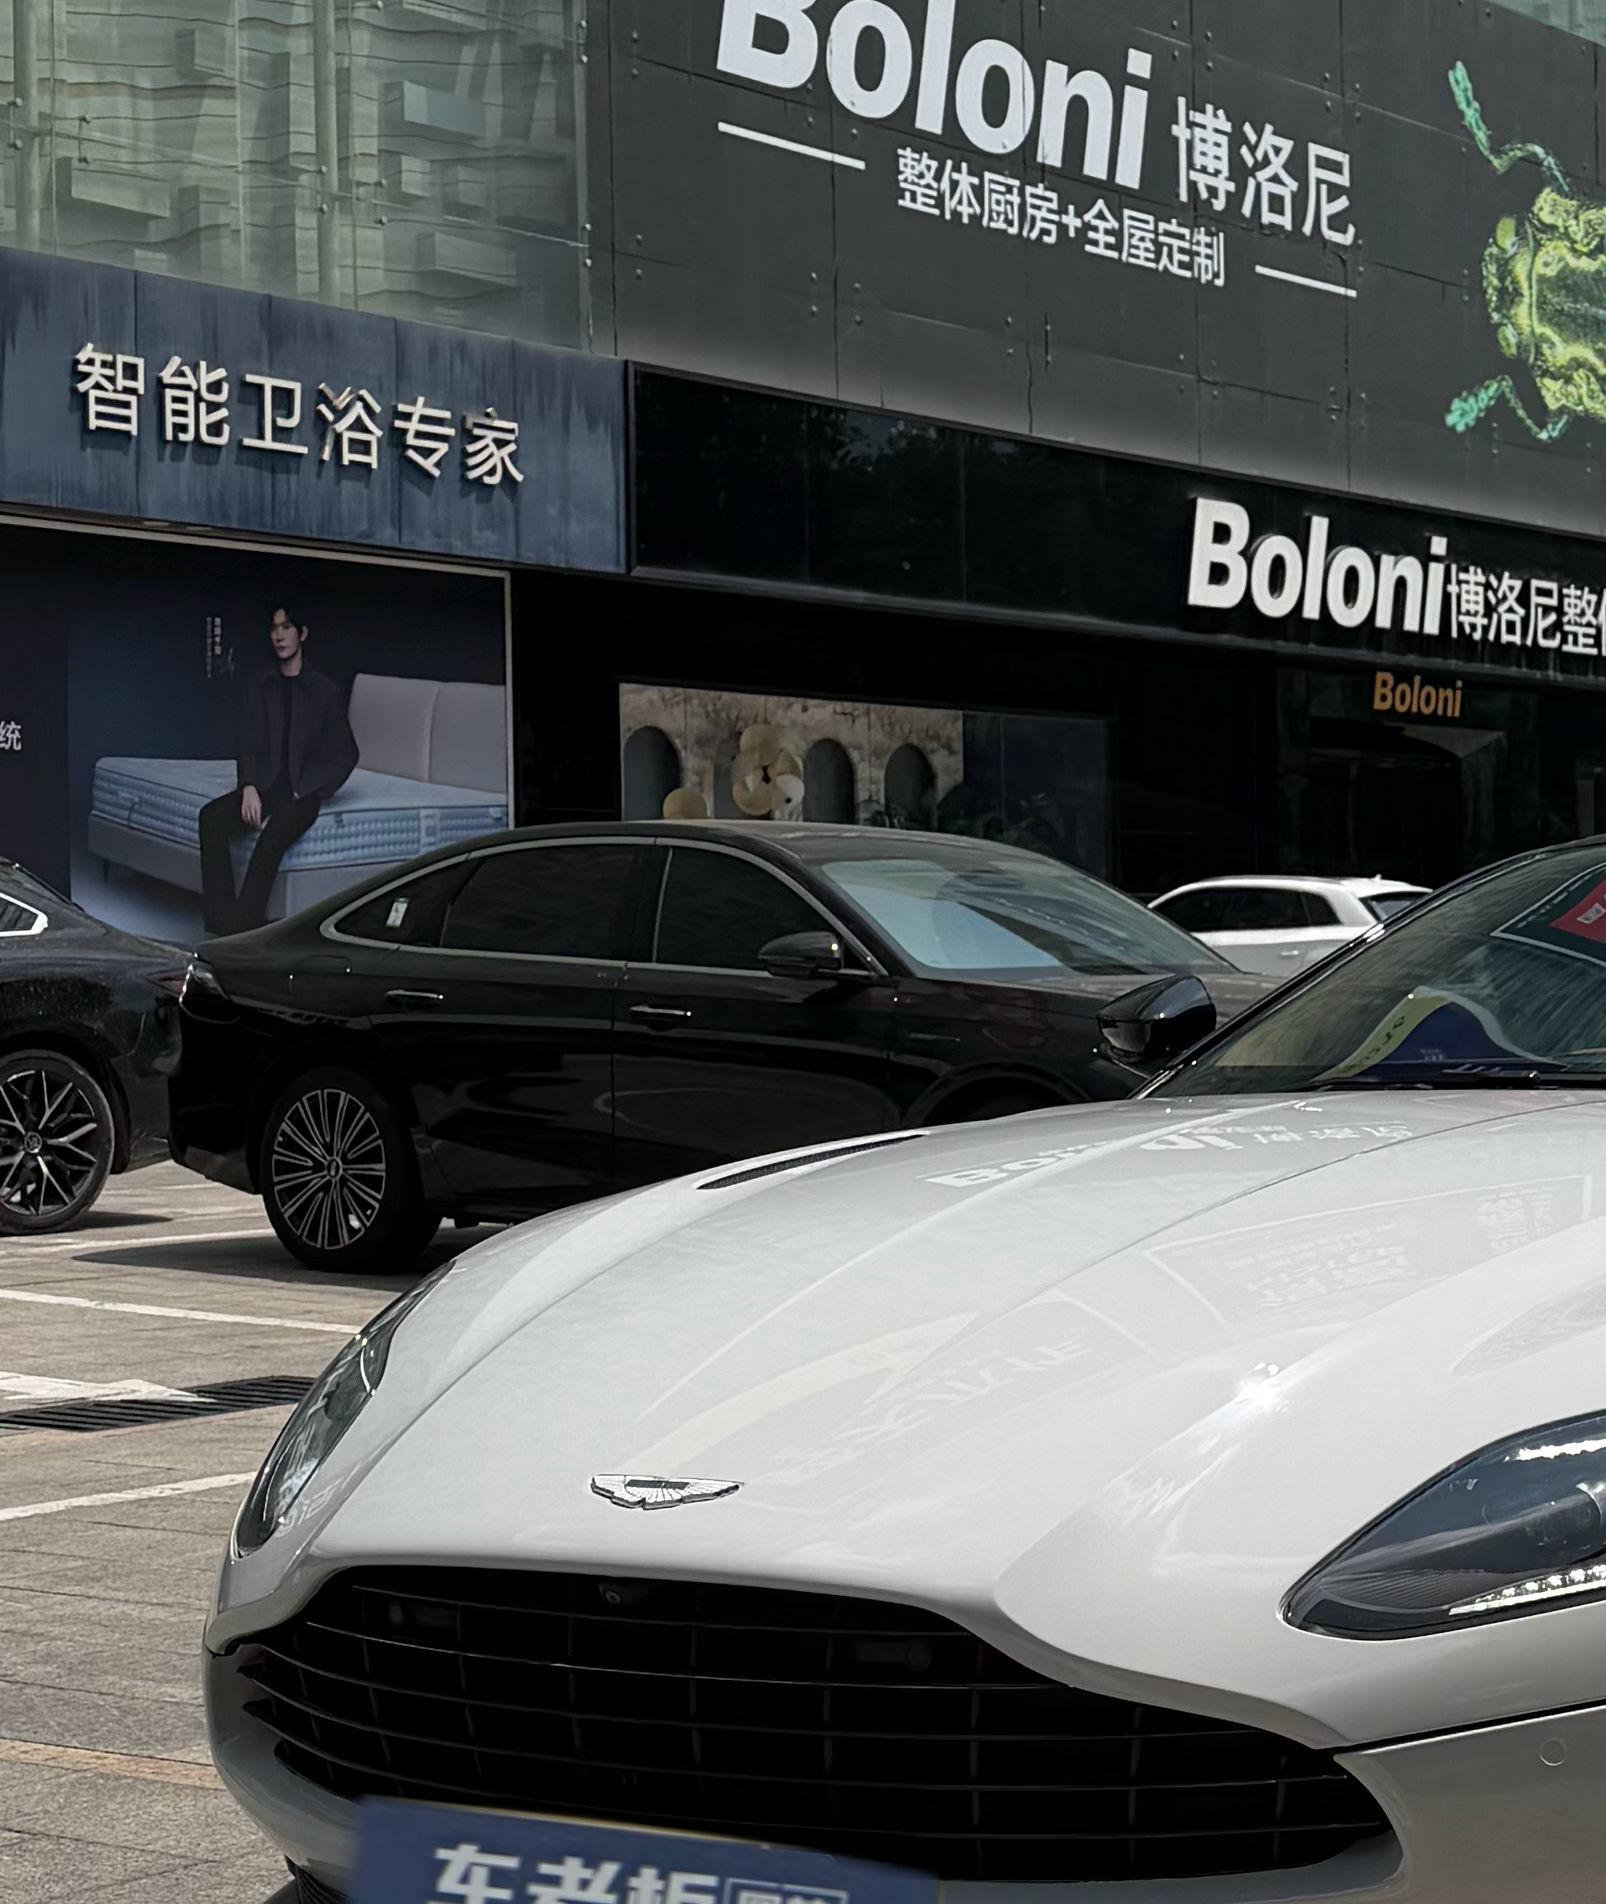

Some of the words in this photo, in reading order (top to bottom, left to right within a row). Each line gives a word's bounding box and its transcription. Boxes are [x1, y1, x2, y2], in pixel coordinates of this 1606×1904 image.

[896, 147, 1226, 286] 整体厨房+全屋定制
[1170, 96, 1357, 246] 博洛尼
[74, 342, 525, 485] 智能卫浴专家
[1187, 496, 1448, 636] Boloni
[1373, 670, 1463, 718] Boloni
